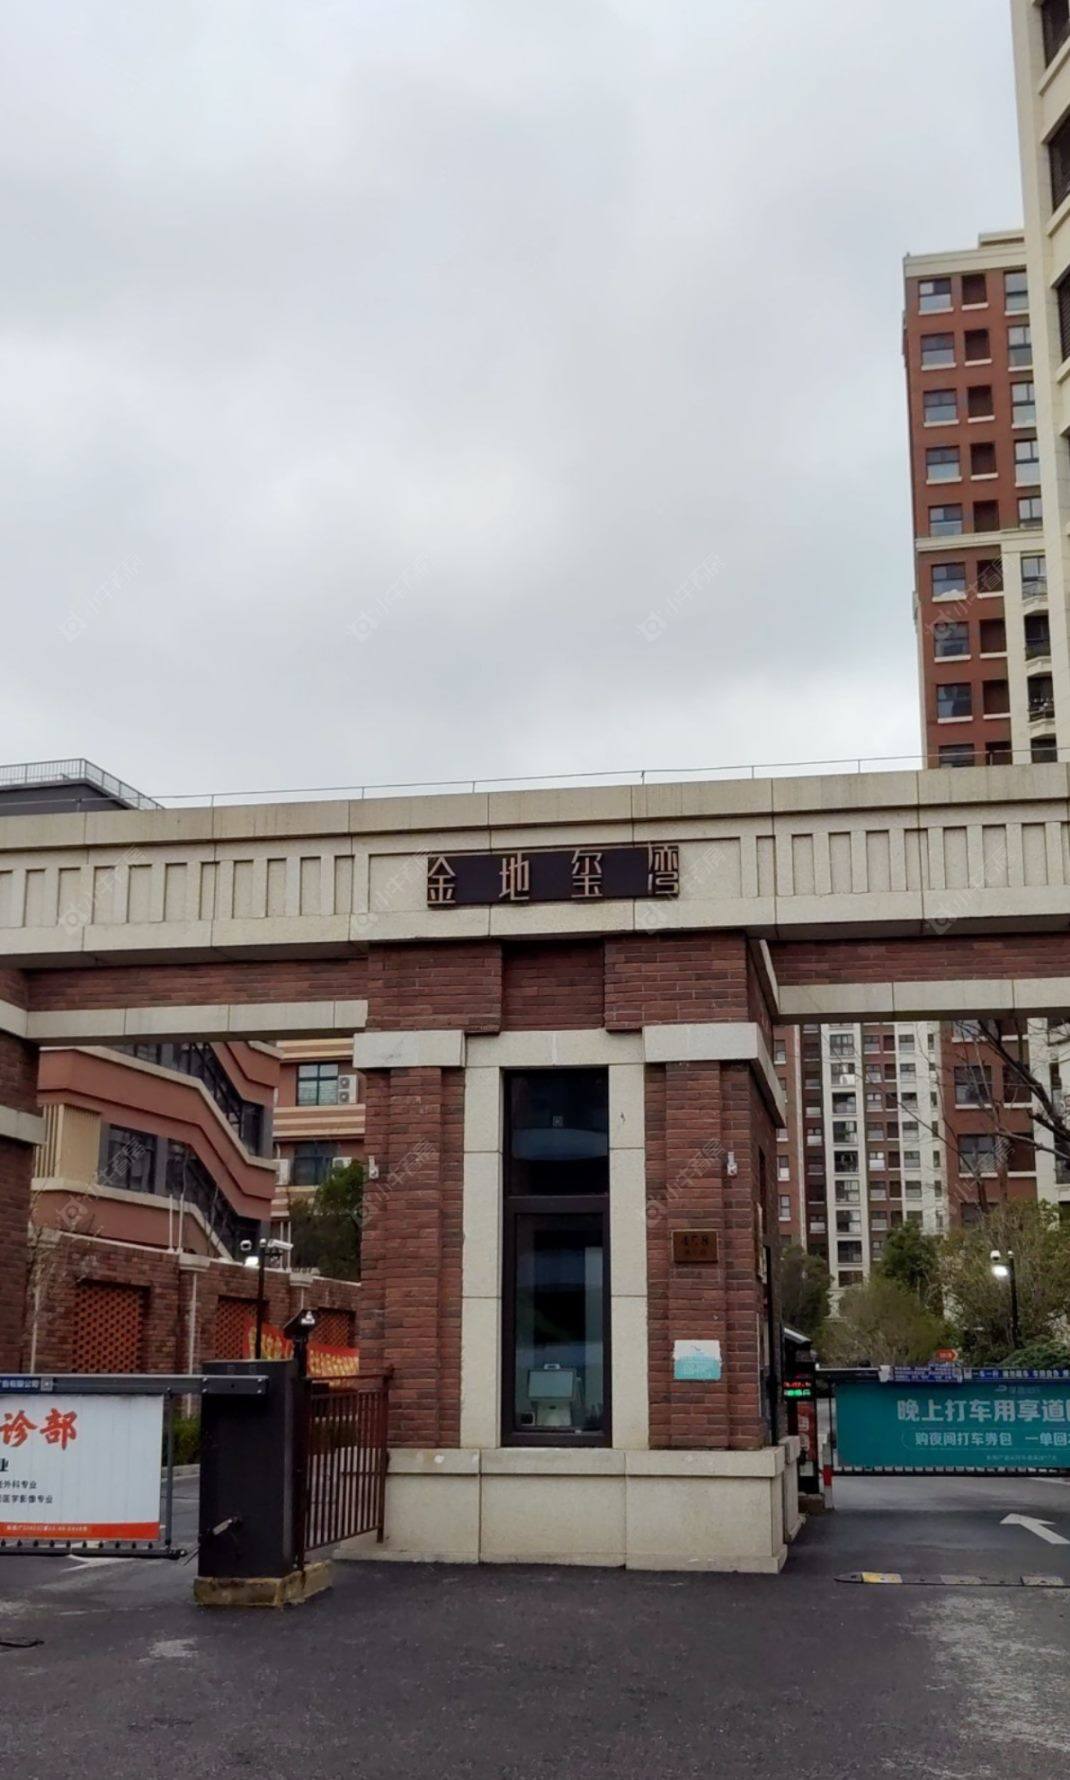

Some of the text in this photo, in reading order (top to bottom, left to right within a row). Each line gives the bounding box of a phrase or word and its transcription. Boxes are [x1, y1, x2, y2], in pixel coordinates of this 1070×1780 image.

[427, 845, 679, 904] 金地玺湾
[897, 1399, 1070, 1422] 晚上打车用享道
[0, 1408, 77, 1450] 诊部
[1025, 1432, 1070, 1446] 一单回
[0, 1494, 53, 1504] 医学影像专业
